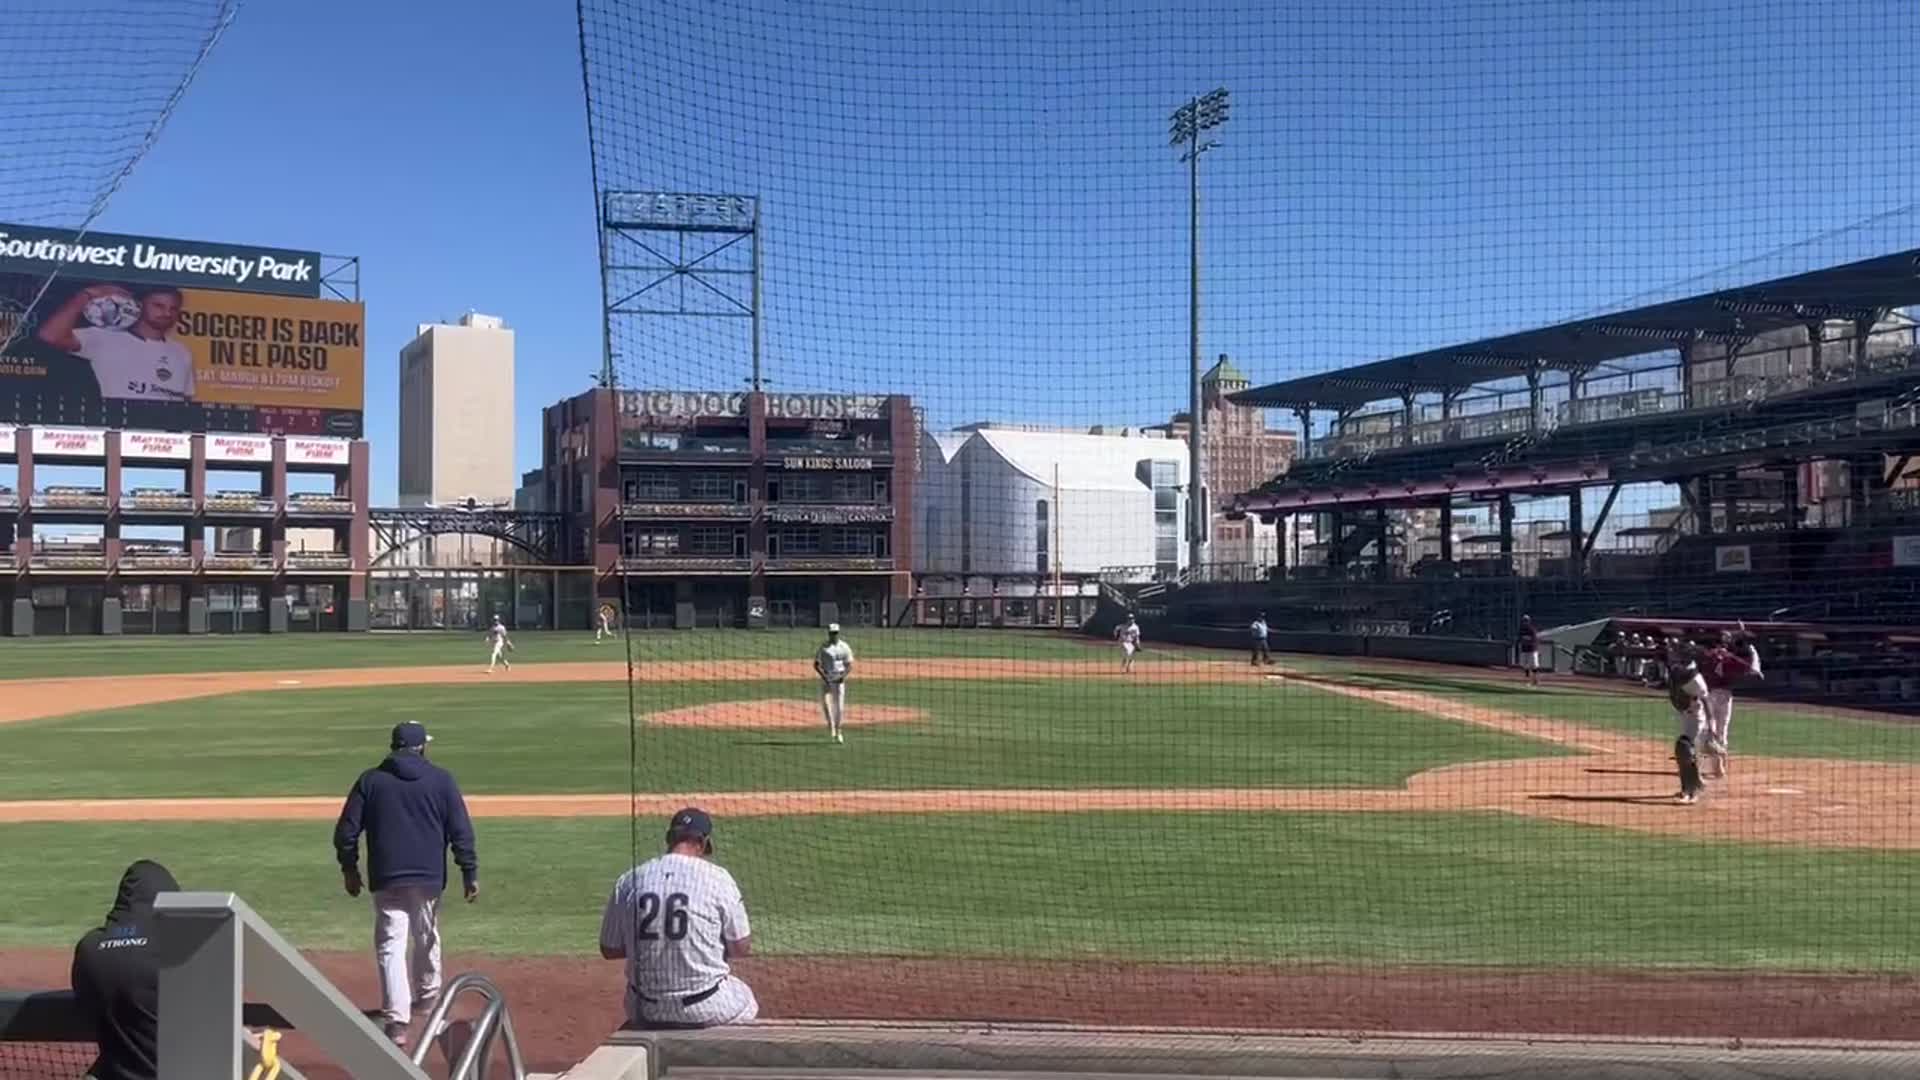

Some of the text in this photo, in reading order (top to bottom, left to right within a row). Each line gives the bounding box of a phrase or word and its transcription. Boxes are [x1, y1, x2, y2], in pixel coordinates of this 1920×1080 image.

[0, 232, 312, 283] Southwest University Park
[176, 311, 360, 347] SOCCER IS BACK
[210, 340, 328, 371] IN EL PASO
[784, 457, 872, 469] SUN KINGS SALOON
[639, 892, 689, 940] 26
[98, 937, 148, 950] STRONG
